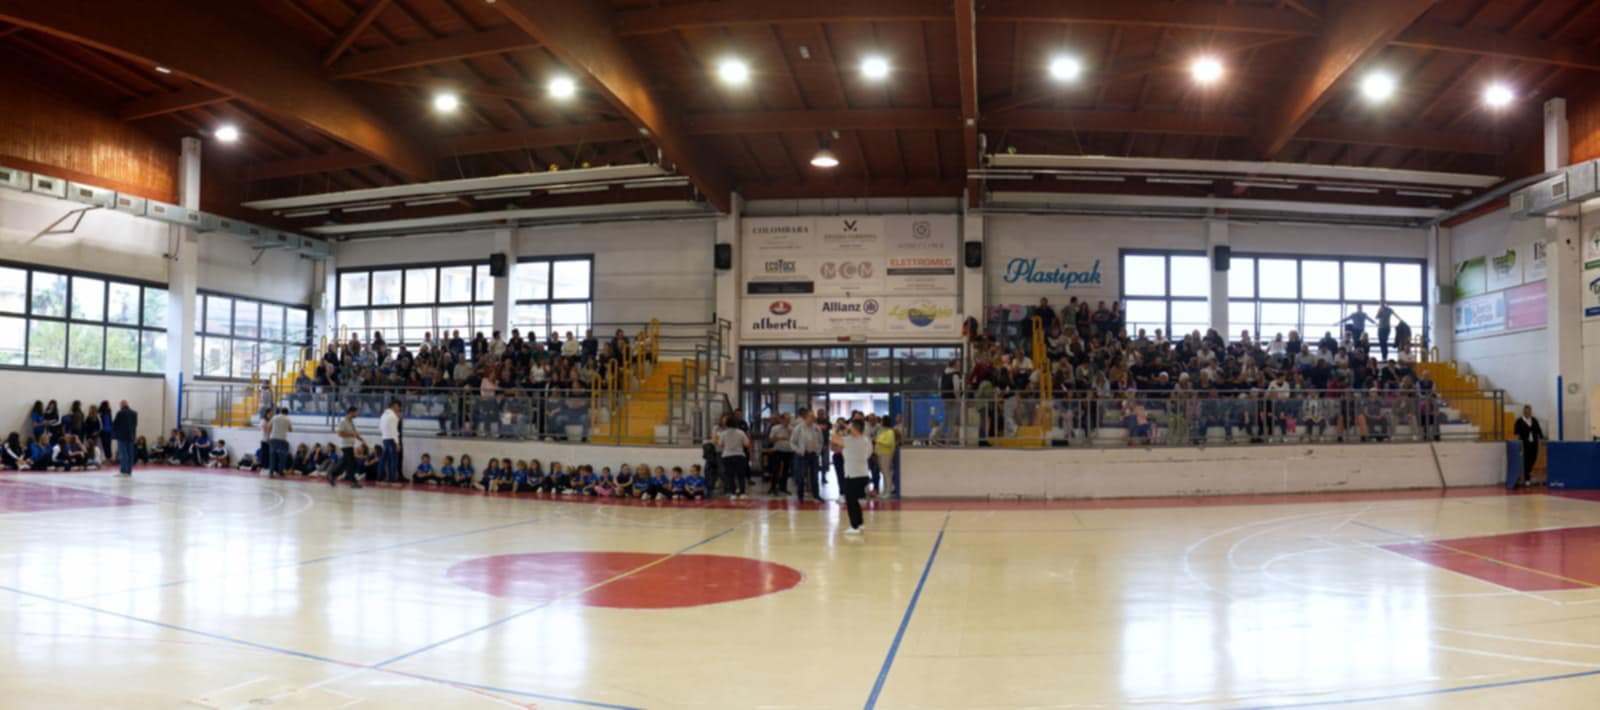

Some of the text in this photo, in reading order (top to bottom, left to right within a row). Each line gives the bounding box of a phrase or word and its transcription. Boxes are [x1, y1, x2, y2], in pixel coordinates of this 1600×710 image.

[889, 258, 953, 266] ELETTROMEC
[1003, 257, 1101, 290] Plastipak
[823, 302, 861, 313] Allianz
[752, 317, 797, 330] alberti
